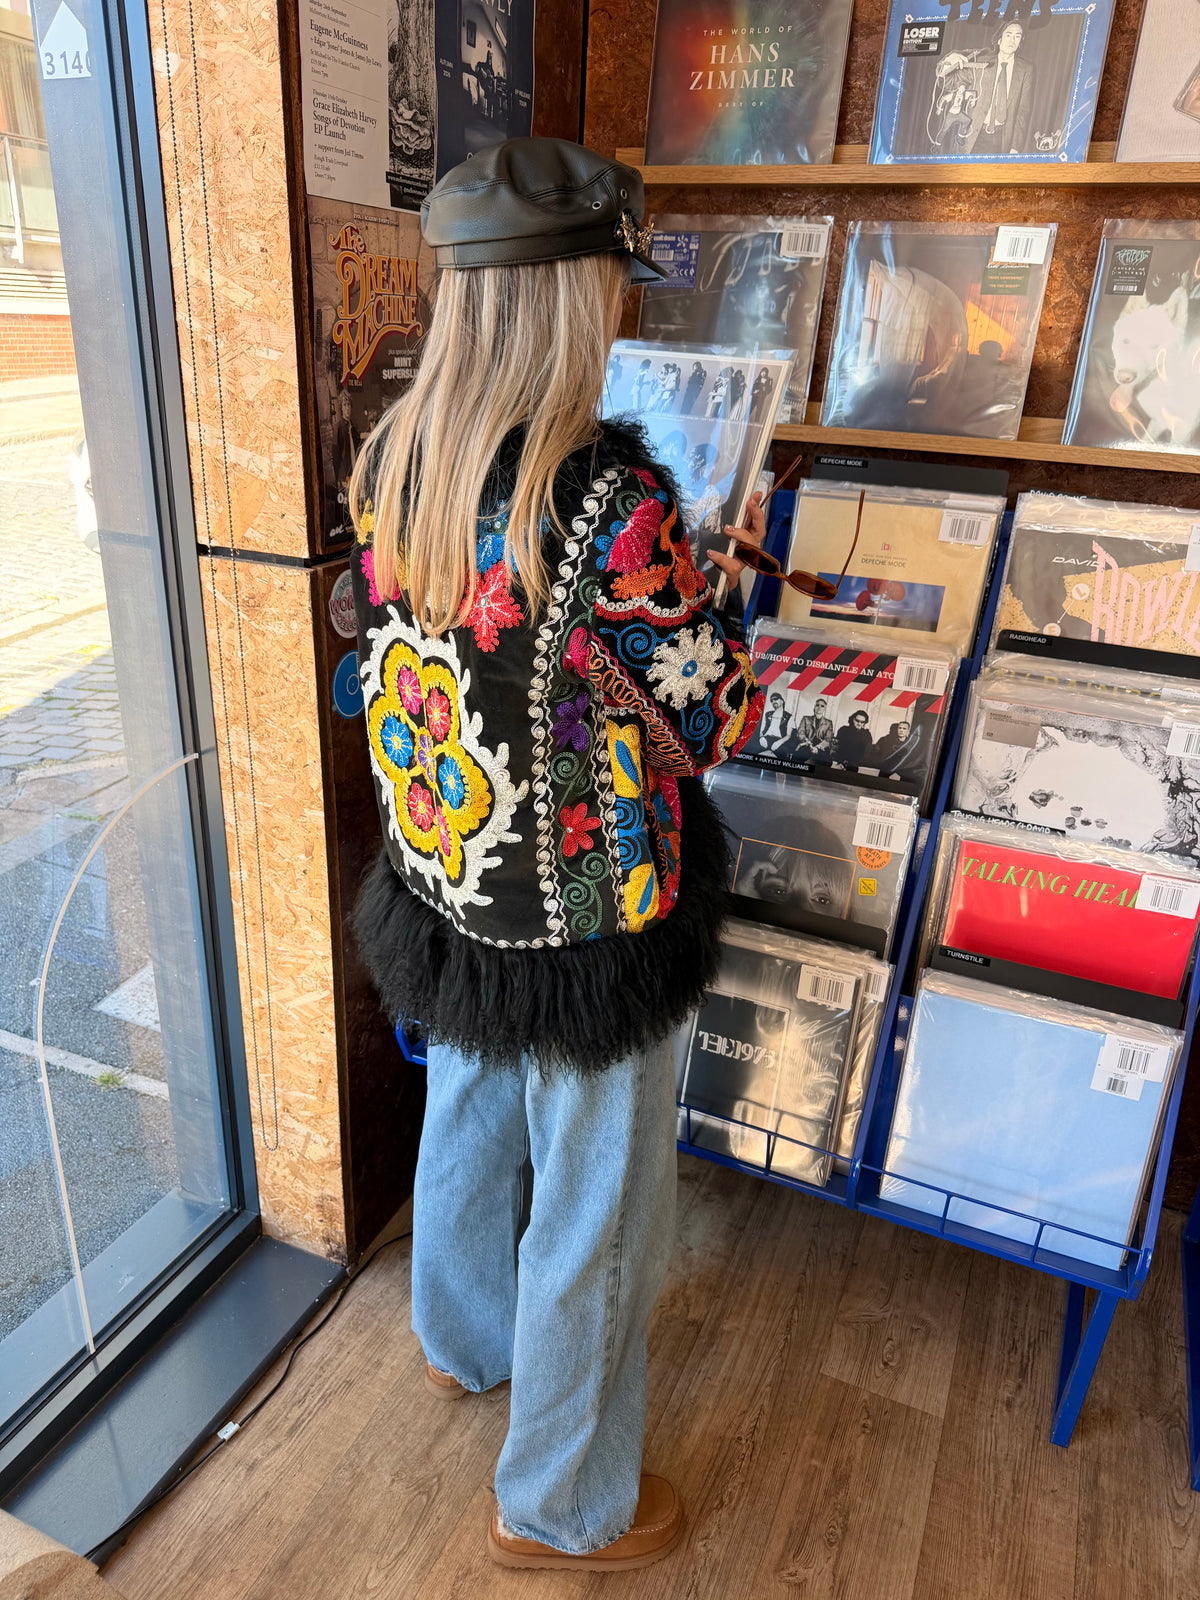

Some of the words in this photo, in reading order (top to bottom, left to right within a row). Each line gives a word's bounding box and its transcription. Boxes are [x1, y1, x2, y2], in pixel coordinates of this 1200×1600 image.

[310, 19, 332, 36] Eugene
[333, 28, 369, 51] McGuinness
[703, 29, 723, 37] THE
[731, 27, 770, 36] WORLD
[778, 25, 793, 34] OF
[903, 26, 940, 39] LOSER
[710, 42, 780, 65] HANS
[689, 67, 795, 91] ZIMMER
[312, 97, 330, 111] Grace
[332, 102, 358, 119] Elizabeth
[359, 111, 377, 128] Harvey
[313, 110, 331, 126] Songs
[332, 117, 340, 126] of
[340, 117, 365, 134] Devotion
[314, 123, 323, 134] EP
[324, 123, 346, 140] Launch
[318, 143, 333, 153] support
[334, 145, 344, 155] from
[328, 222, 367, 253] The
[336, 251, 418, 320] DREAM
[332, 296, 423, 384] MACHINE
[394, 357, 412, 368] MINT
[820, 457, 846, 465] DEPECHE
[846, 459, 863, 467] MODE
[861, 558, 886, 566] DEPECHE
[1090, 540, 1200, 651] BOWI
[1009, 633, 1047, 643] RADIOHEAD
[792, 657, 805, 666] TO
[806, 659, 859, 674] DISMANTLE
[860, 665, 875, 677] AN
[759, 757, 781, 766] HAYLEY
[782, 761, 809, 771] WILLIAMS
[962, 857, 1070, 895] TALKING
[946, 949, 984, 964] TURNSTILE
